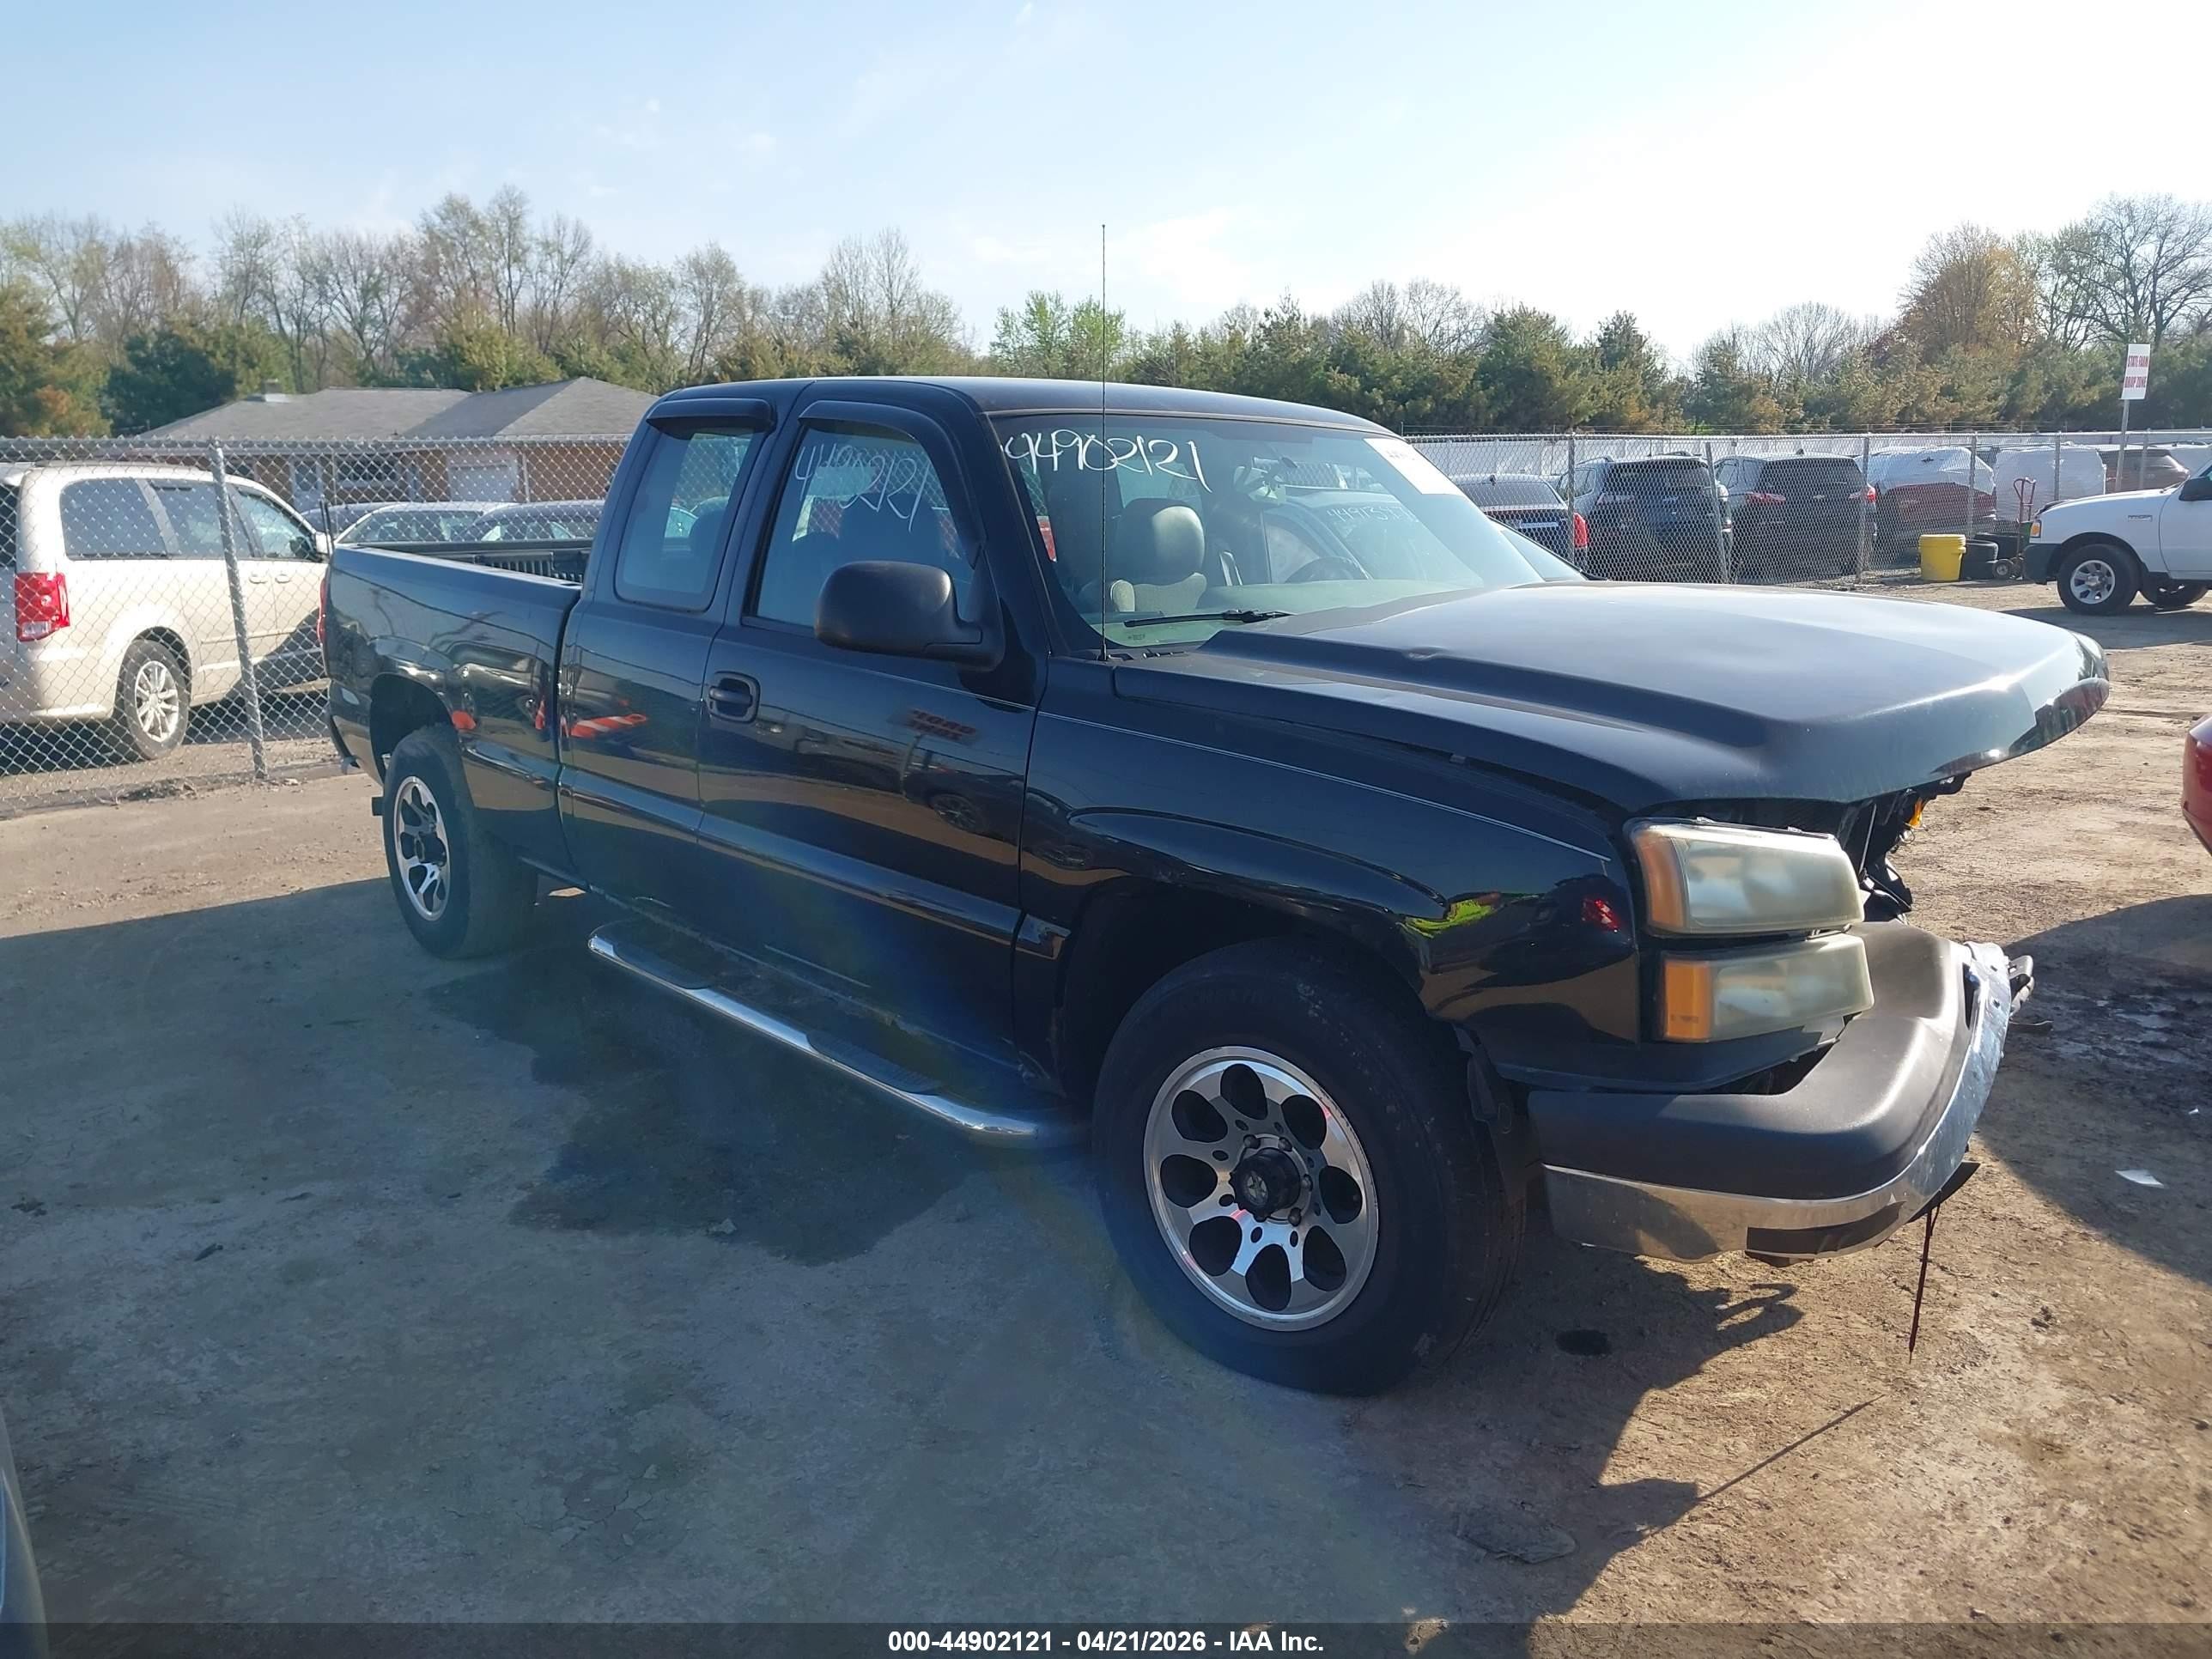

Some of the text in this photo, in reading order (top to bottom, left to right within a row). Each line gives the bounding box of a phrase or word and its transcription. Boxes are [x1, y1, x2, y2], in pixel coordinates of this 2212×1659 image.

[2128, 355, 2148, 368] STATE FARM
[2124, 376, 2147, 387] DROP ZONE
[1003, 428, 1213, 494] 44902121
